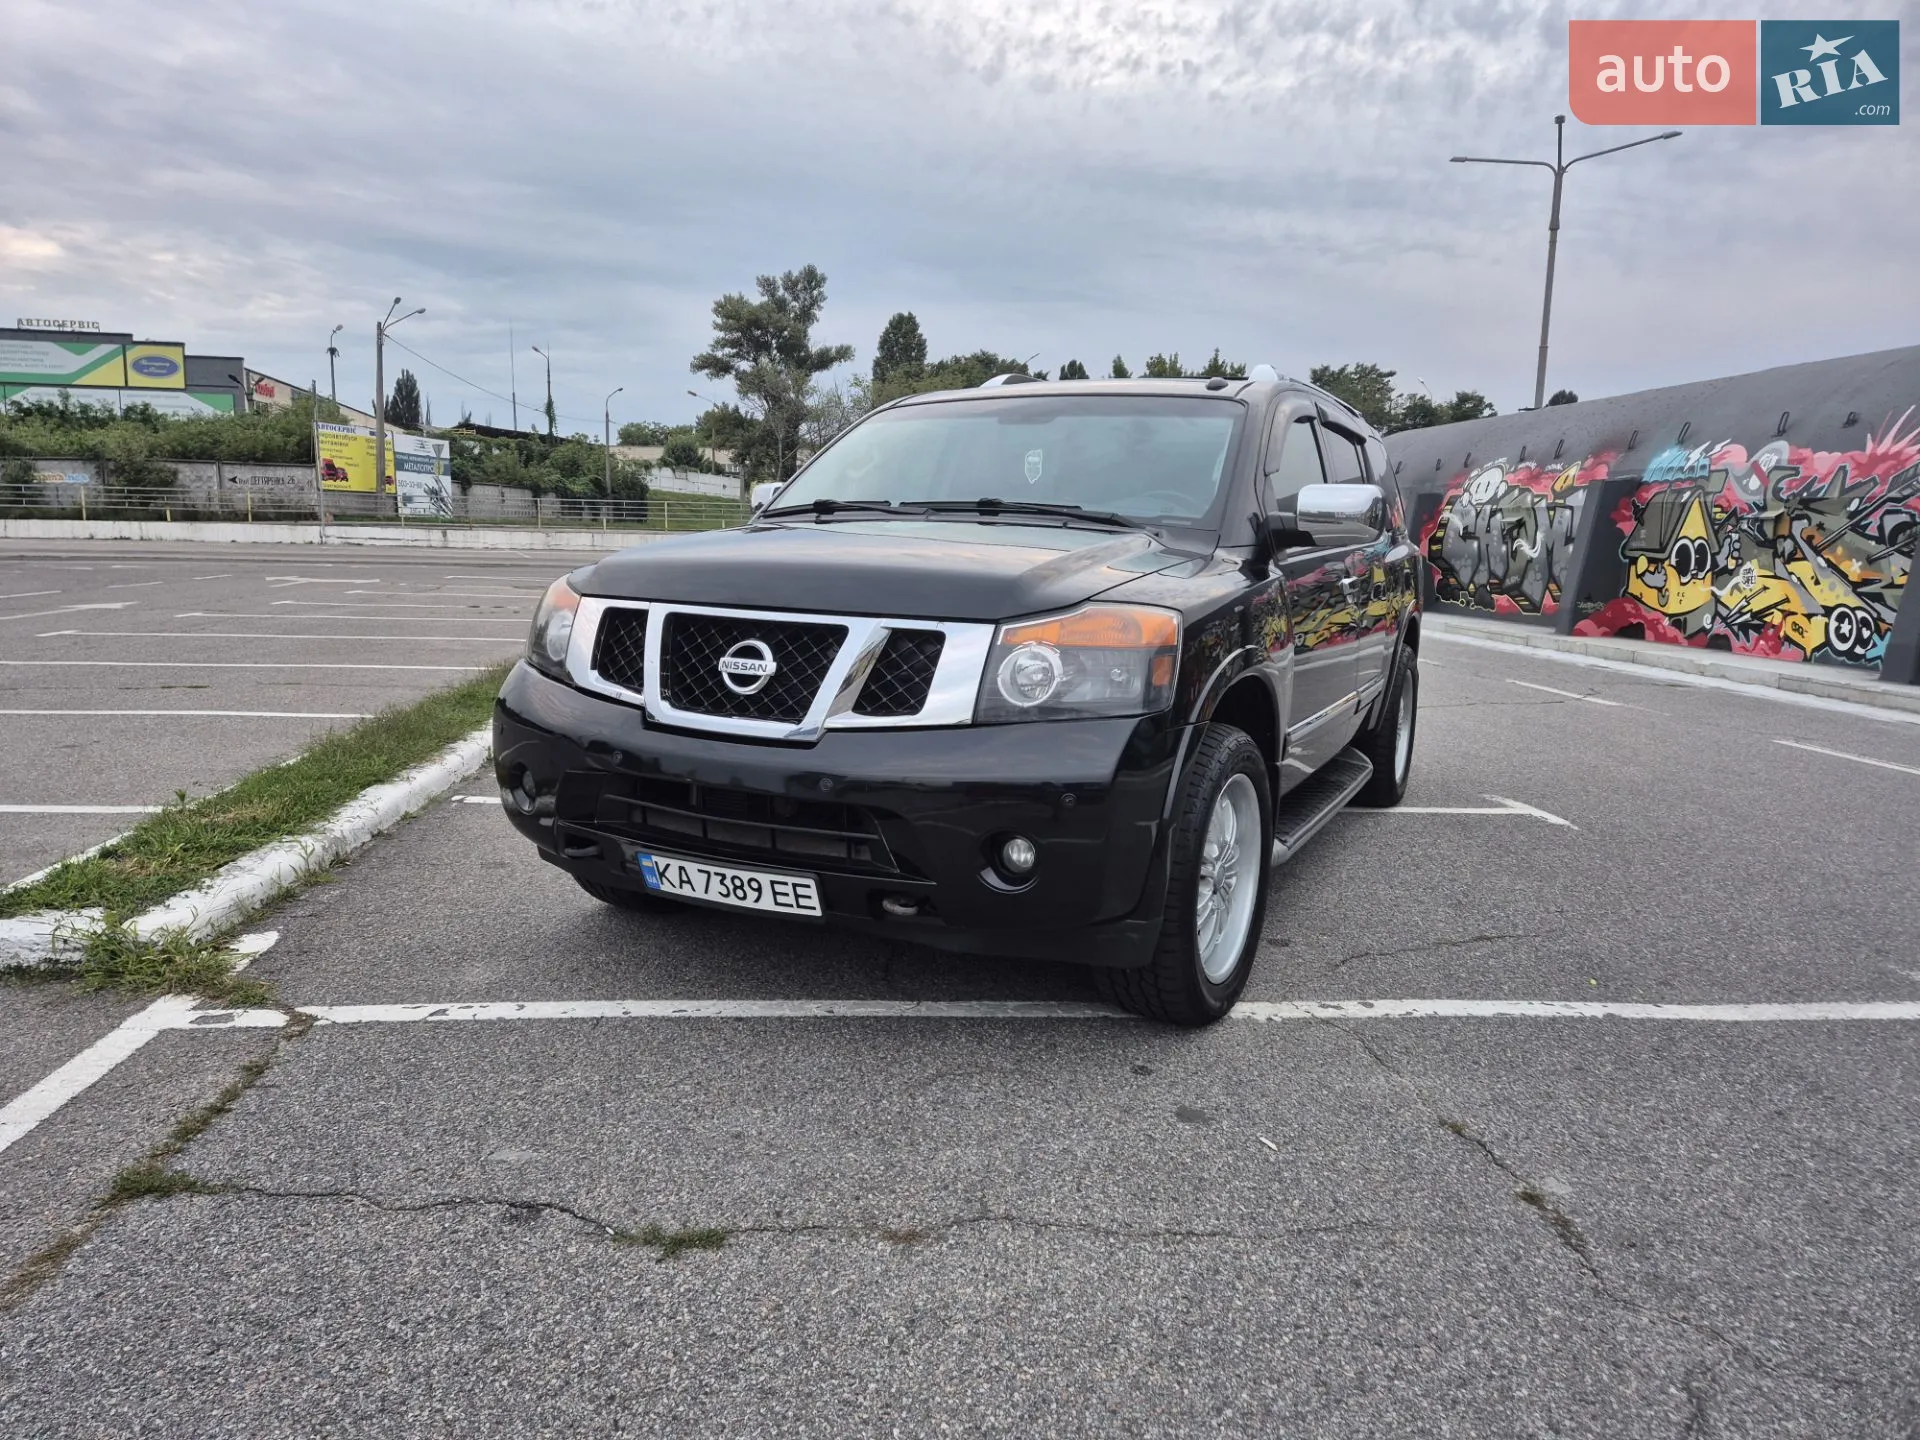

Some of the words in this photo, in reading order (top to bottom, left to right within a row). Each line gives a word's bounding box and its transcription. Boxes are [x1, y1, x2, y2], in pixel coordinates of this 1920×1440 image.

[17, 318, 99, 329] АВТОСЕРВІС
[722, 661, 767, 672] NISSAN
[646, 876, 658, 885] UA
[655, 861, 695, 892] KA
[697, 868, 762, 904] 7389
[770, 880, 817, 910] EE
